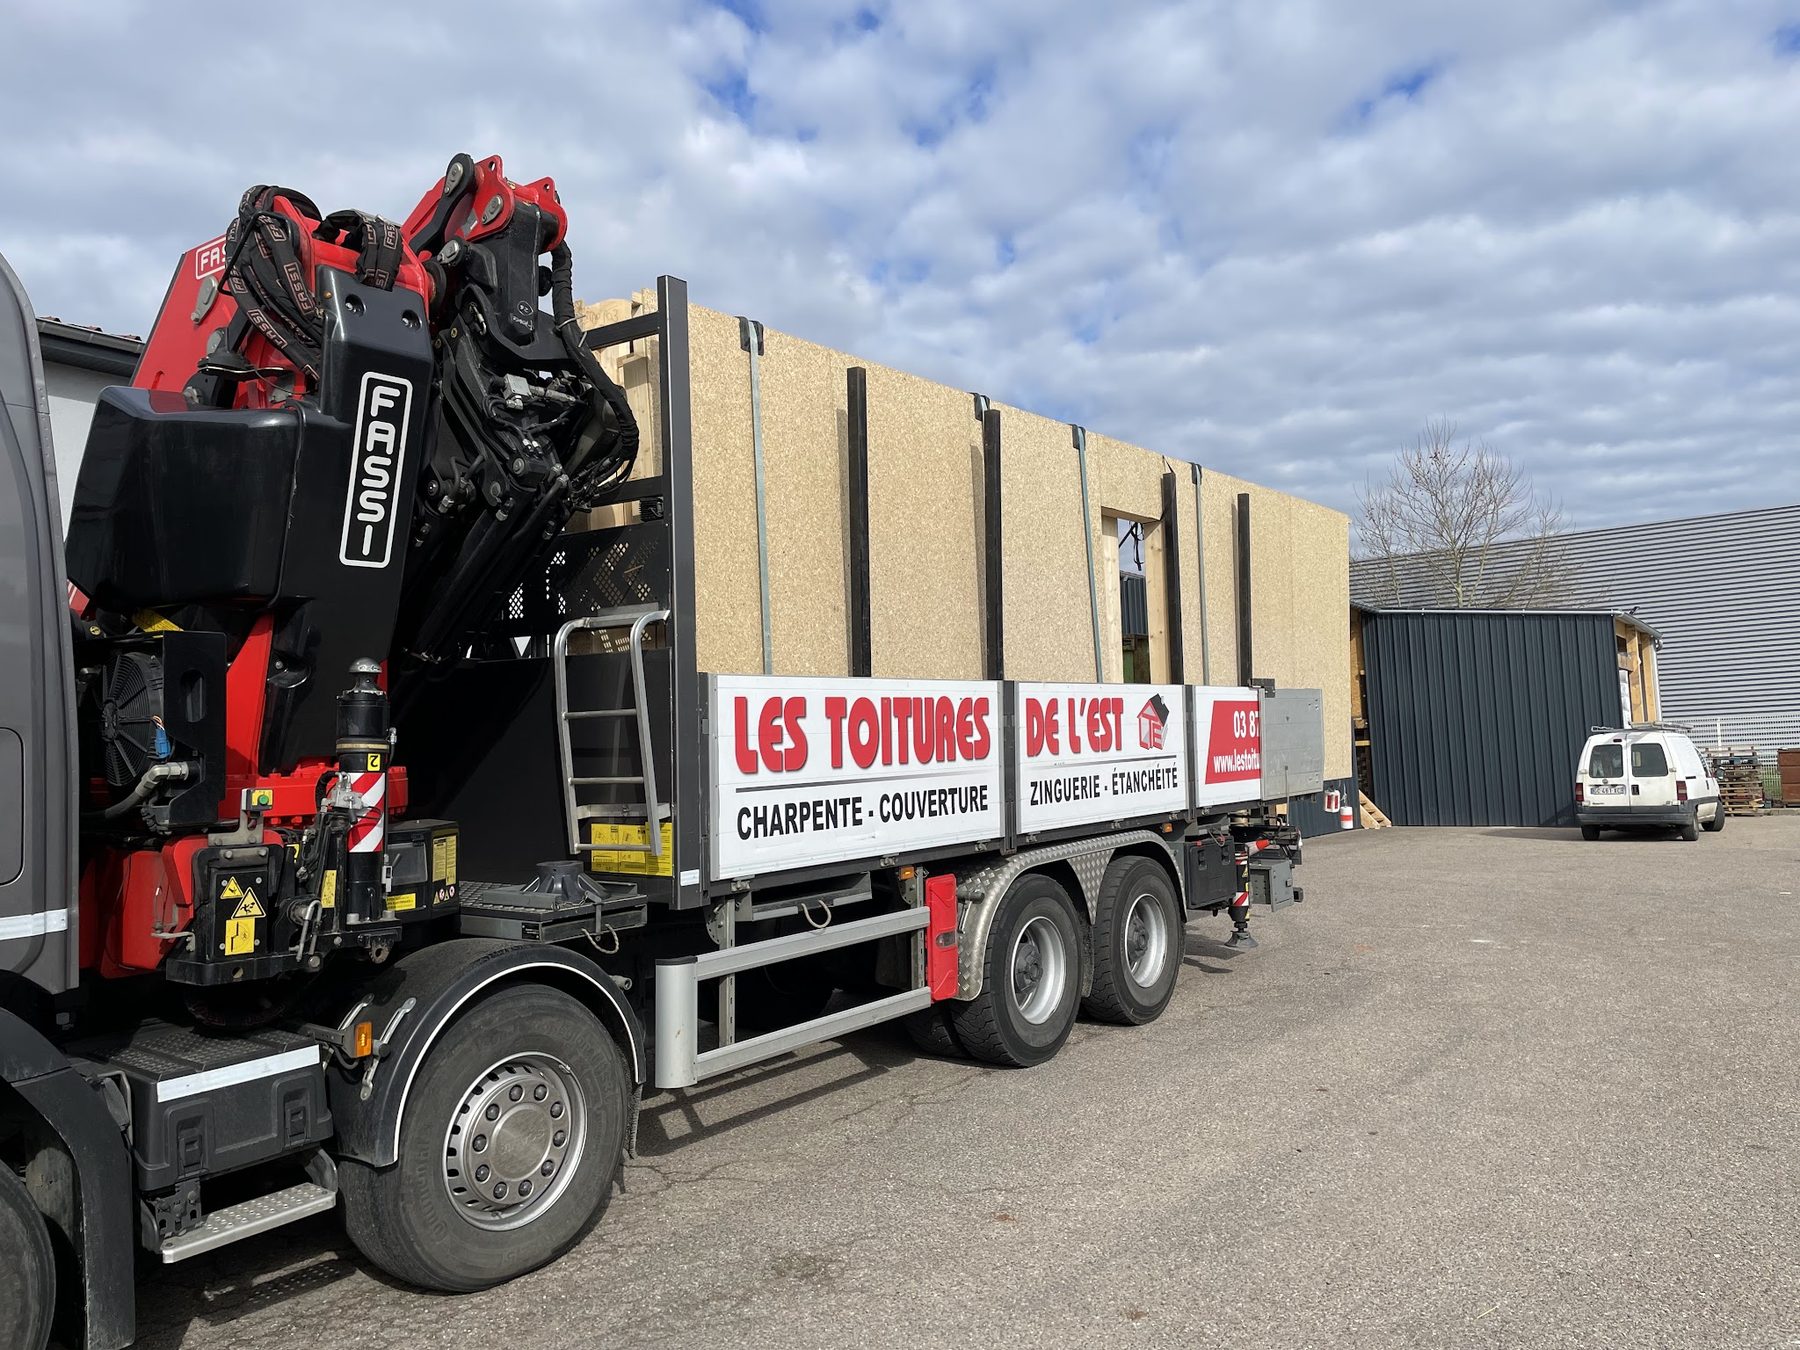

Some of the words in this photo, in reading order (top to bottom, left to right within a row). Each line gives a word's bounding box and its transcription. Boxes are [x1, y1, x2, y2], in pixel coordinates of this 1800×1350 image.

[287, 266, 311, 310] FASSI
[357, 385, 400, 556] FASSI
[734, 696, 808, 774] LES
[825, 695, 991, 769] TOITURES
[1026, 698, 1060, 757] DE
[1068, 697, 1124, 754] L'EST
[1233, 710, 1247, 738] 03
[737, 796, 863, 840] CHARPENTE
[879, 784, 988, 822] COUVERTURE
[1030, 774, 1100, 806] ZINGUERIE
[1112, 762, 1178, 796] ÉTANCHÉITÉ
